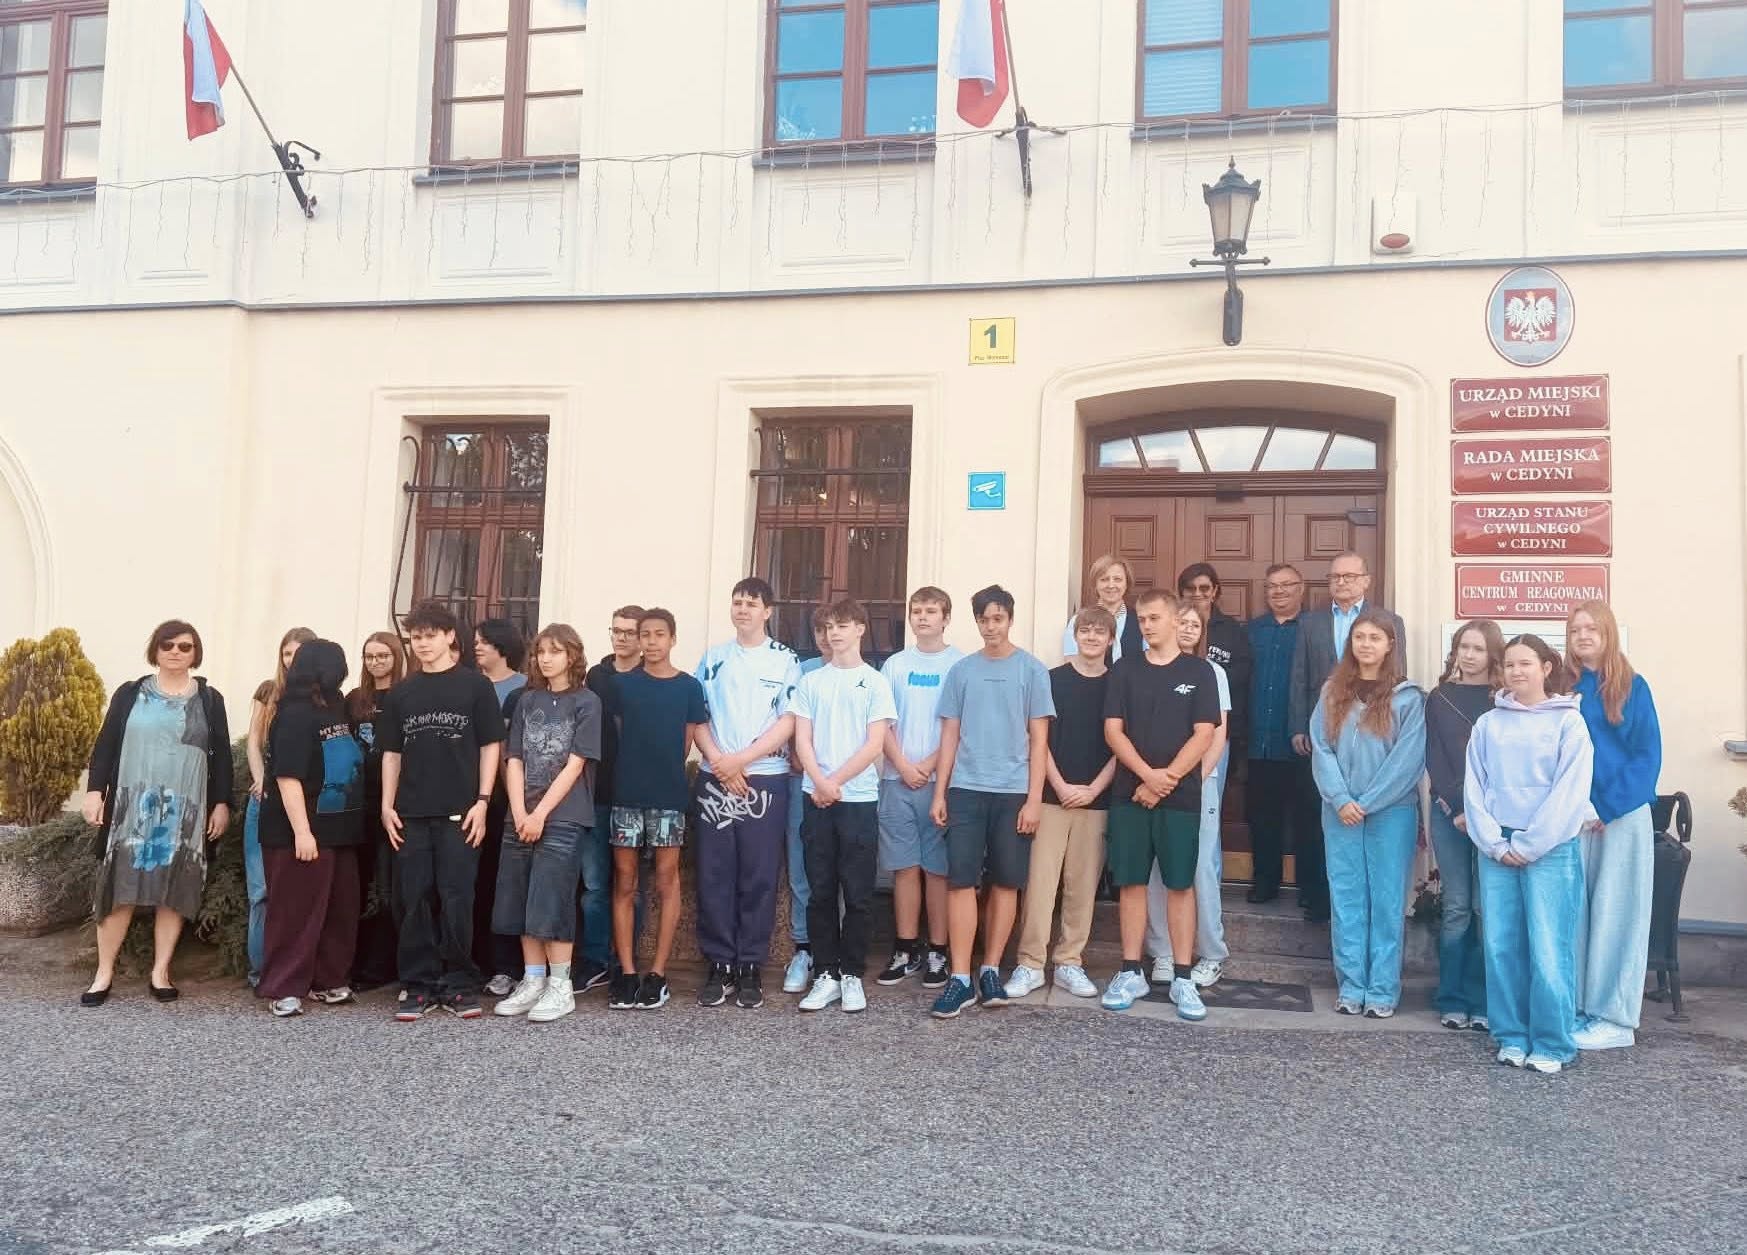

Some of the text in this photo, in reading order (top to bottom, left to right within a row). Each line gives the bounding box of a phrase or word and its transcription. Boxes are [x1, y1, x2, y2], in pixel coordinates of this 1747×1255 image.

[984, 324, 996, 348] 1
[1459, 385, 1600, 403] URZĄD MIEJSKI
[1490, 404, 1571, 419] w CEDYNI
[1463, 449, 1600, 465] RADA MIEJSKA
[1490, 467, 1573, 482] w CEDYNI
[1476, 507, 1588, 520] URZĄD STANU
[1483, 522, 1581, 535] CYWILNEGO
[1497, 538, 1567, 549] w CEDYNI
[1500, 570, 1565, 583] GMINNE
[1462, 586, 1603, 600] CENTRUM REAGOWANIA
[1515, 602, 1568, 613] CEDYNI
[1173, 683, 1197, 695] 4F
